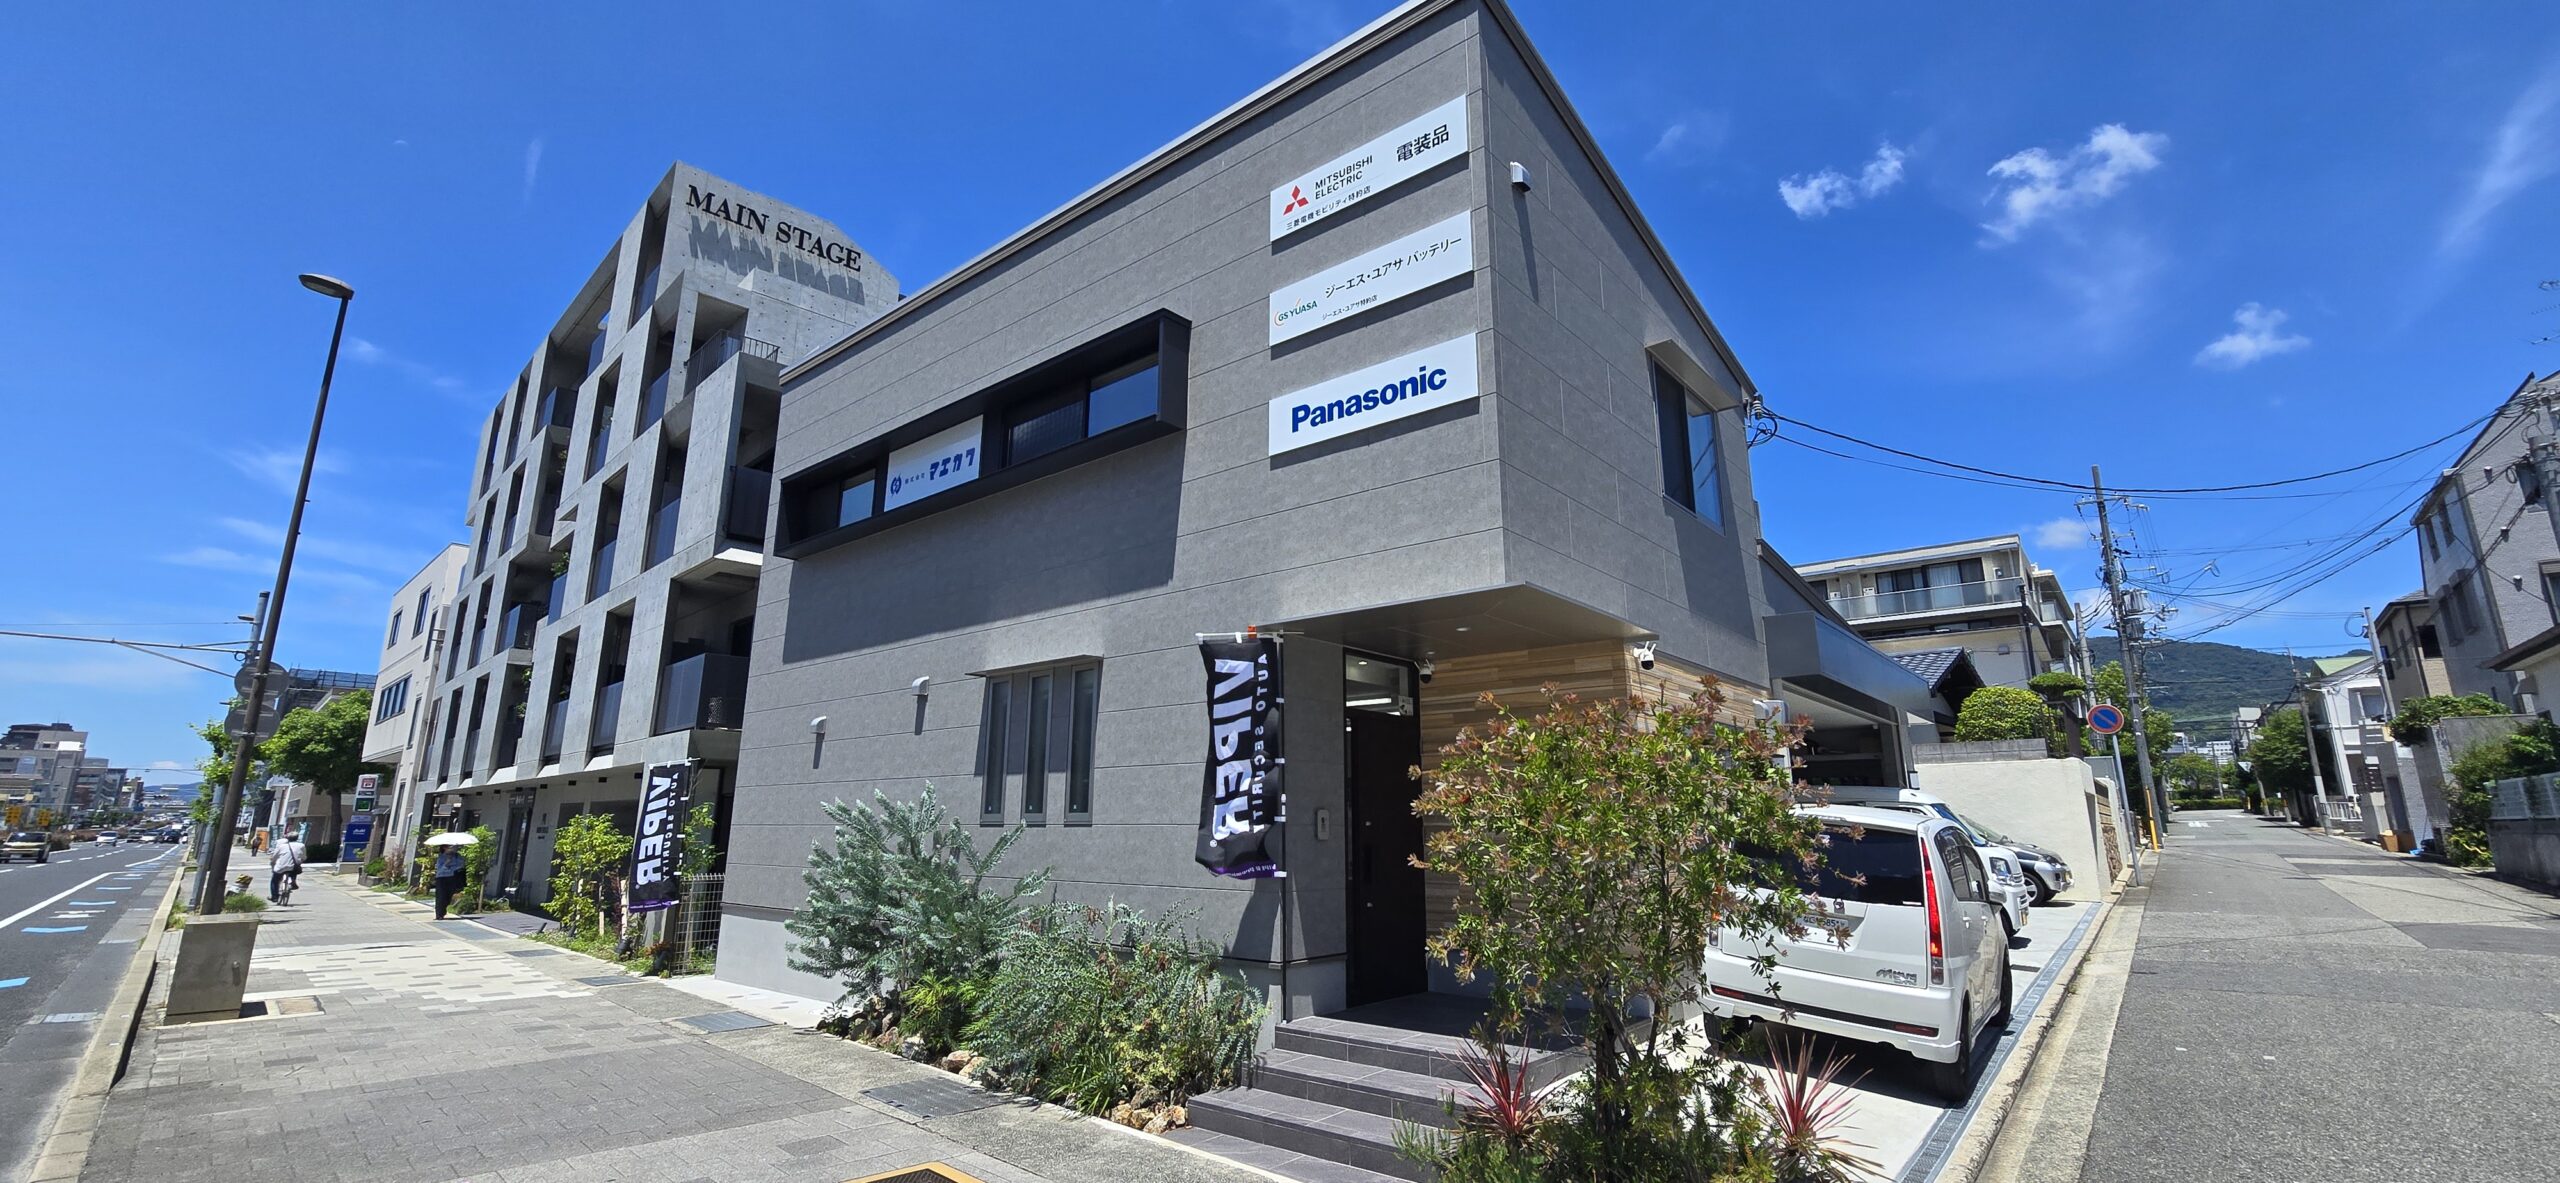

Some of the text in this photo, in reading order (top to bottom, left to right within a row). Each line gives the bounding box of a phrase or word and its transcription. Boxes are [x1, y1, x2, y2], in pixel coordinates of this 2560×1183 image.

[1396, 123, 1450, 163] 電装品
[1314, 155, 1373, 191] MITSUBISHI
[1314, 170, 1364, 200] ELECTRIC
[685, 184, 862, 273] MAIN STAGE
[1285, 185, 1372, 231] 三菱電機モビリティ特約店
[1325, 237, 1462, 299] ジーエス・ユアサ バッテリー
[1277, 300, 1318, 322] GS YUASA
[1291, 365, 1448, 433] Panasonic
